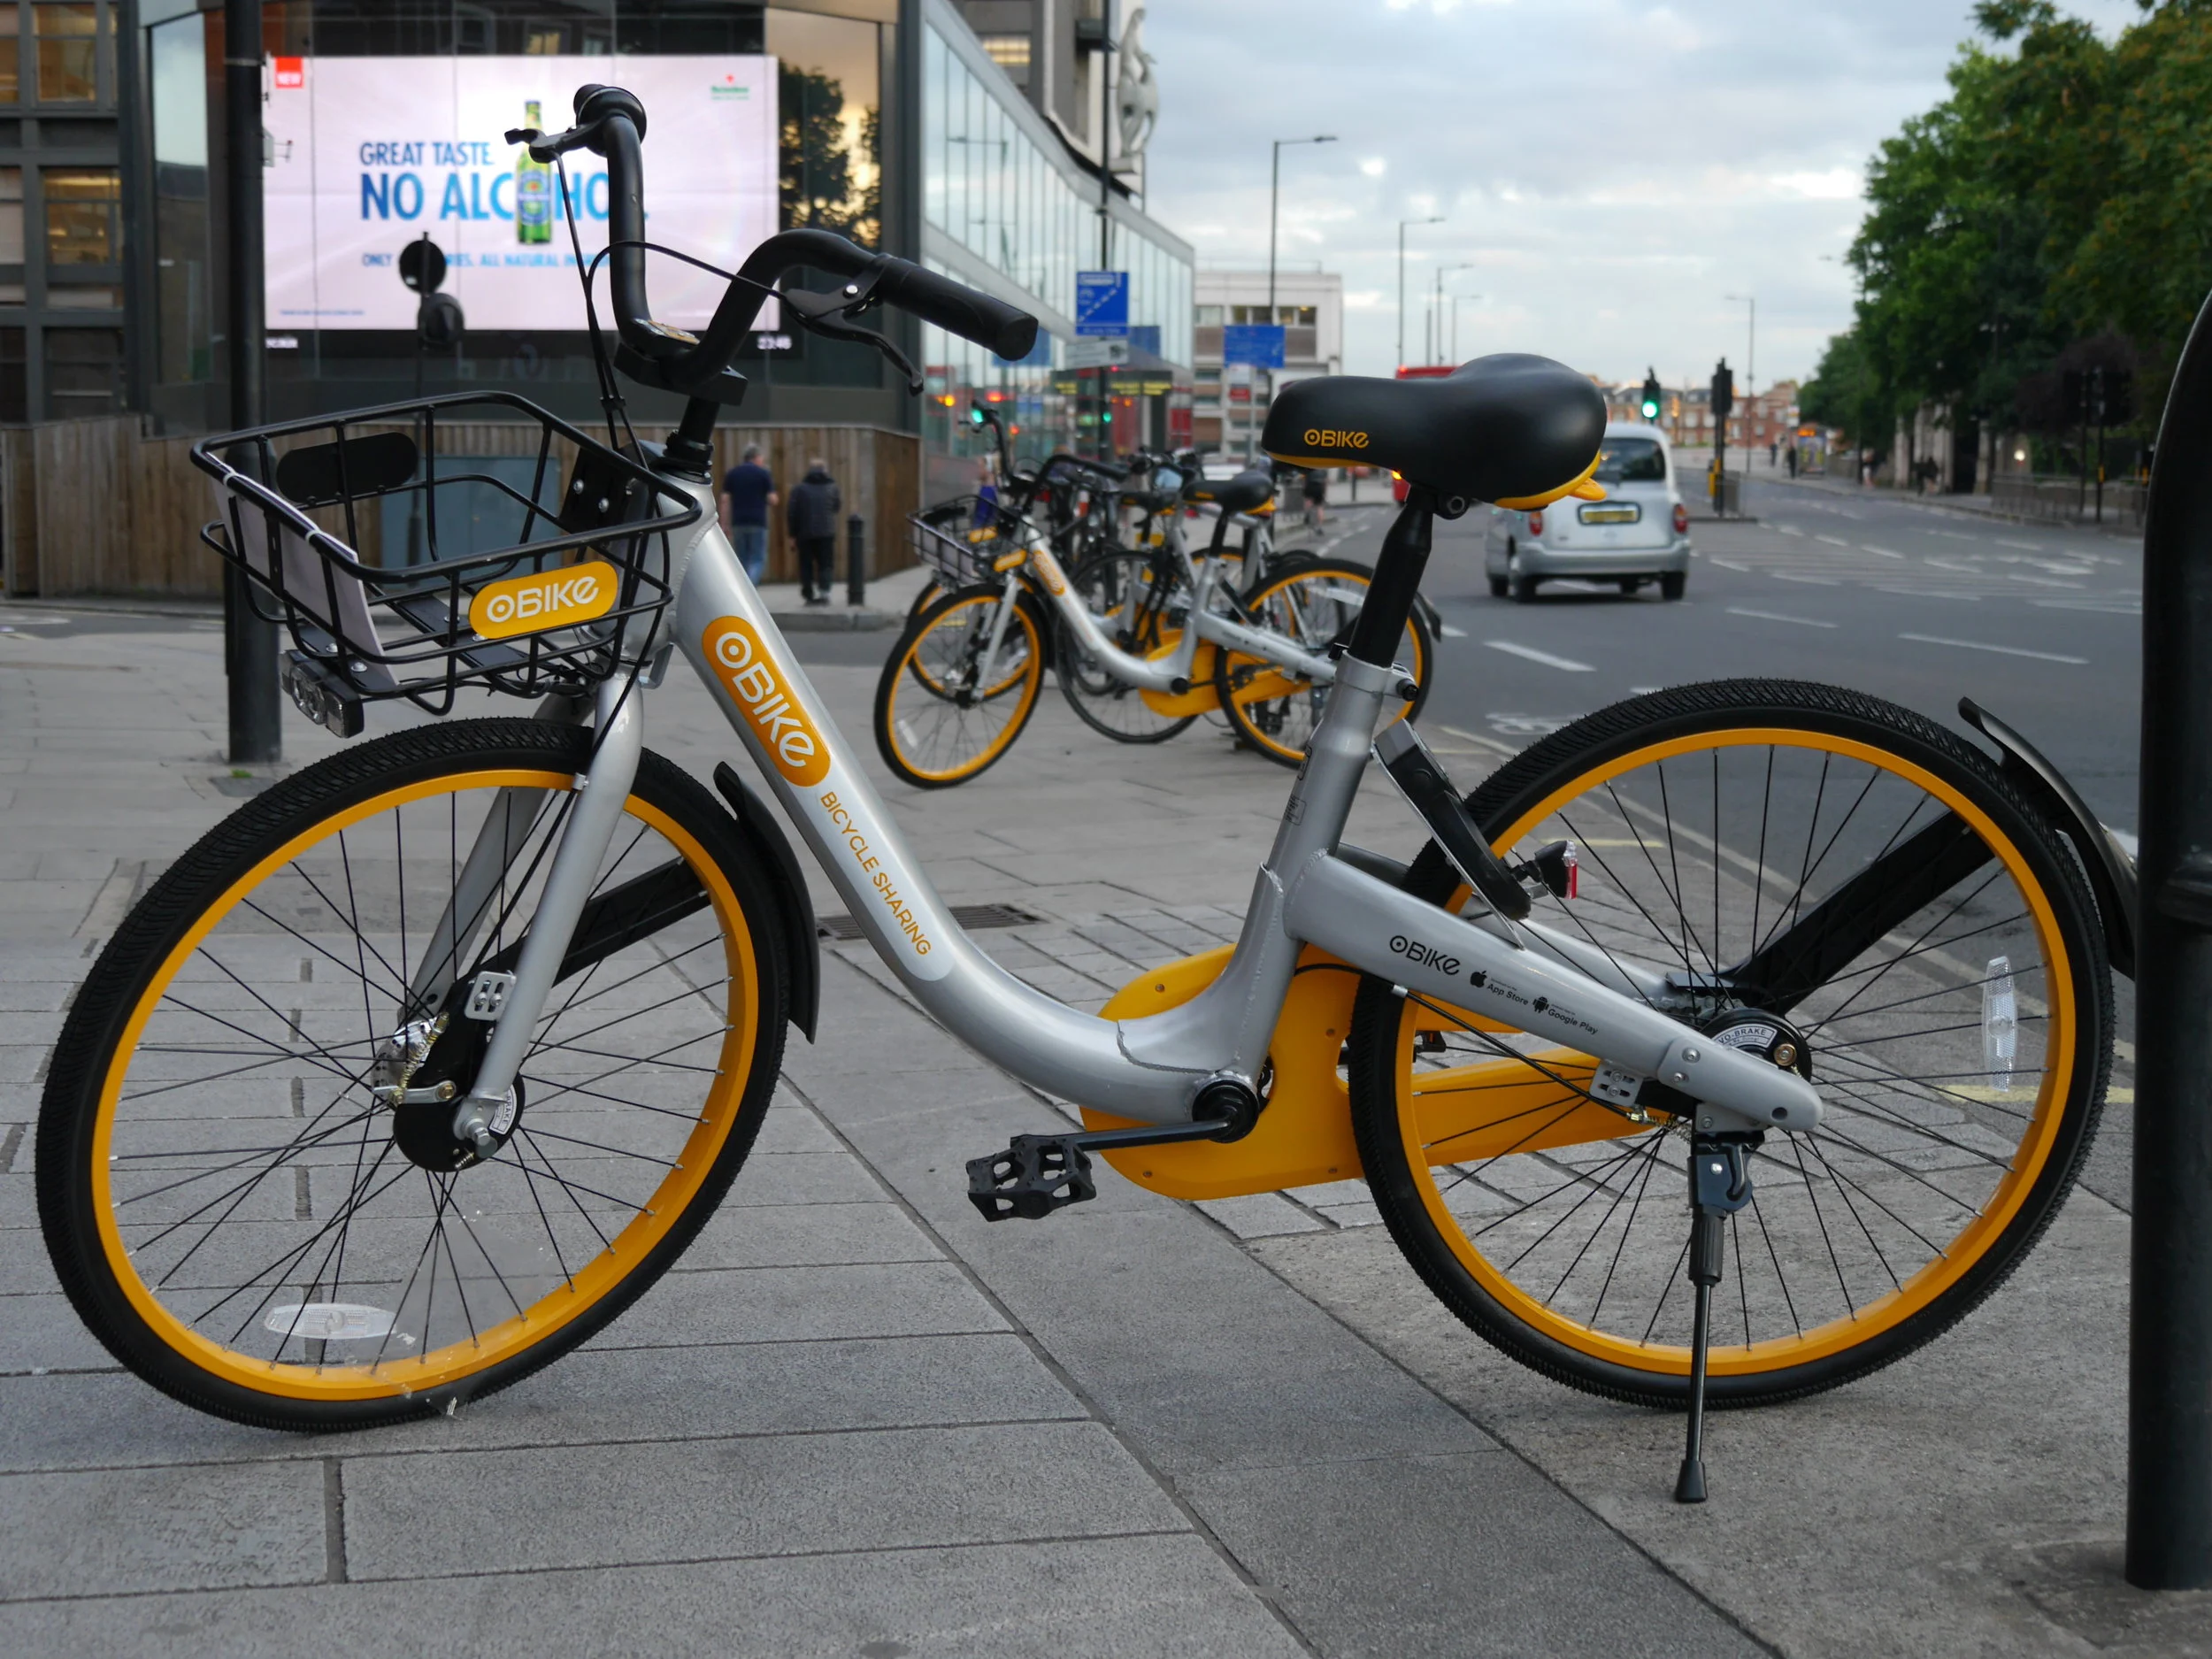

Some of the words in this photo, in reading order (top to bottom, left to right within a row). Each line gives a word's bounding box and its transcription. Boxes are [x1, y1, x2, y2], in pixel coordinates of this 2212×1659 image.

[359, 141, 425, 166] GREAT
[360, 172, 425, 221] NO
[820, 791, 879, 872] BICYCLE
[872, 872, 932, 956] SHARING
[1486, 983, 1505, 996] App
[1506, 991, 1529, 1005] Store
[1548, 1008, 1578, 1026] Google
[1579, 1020, 1599, 1035] Play
[1718, 1028, 1767, 1045] VO-BRAKE
